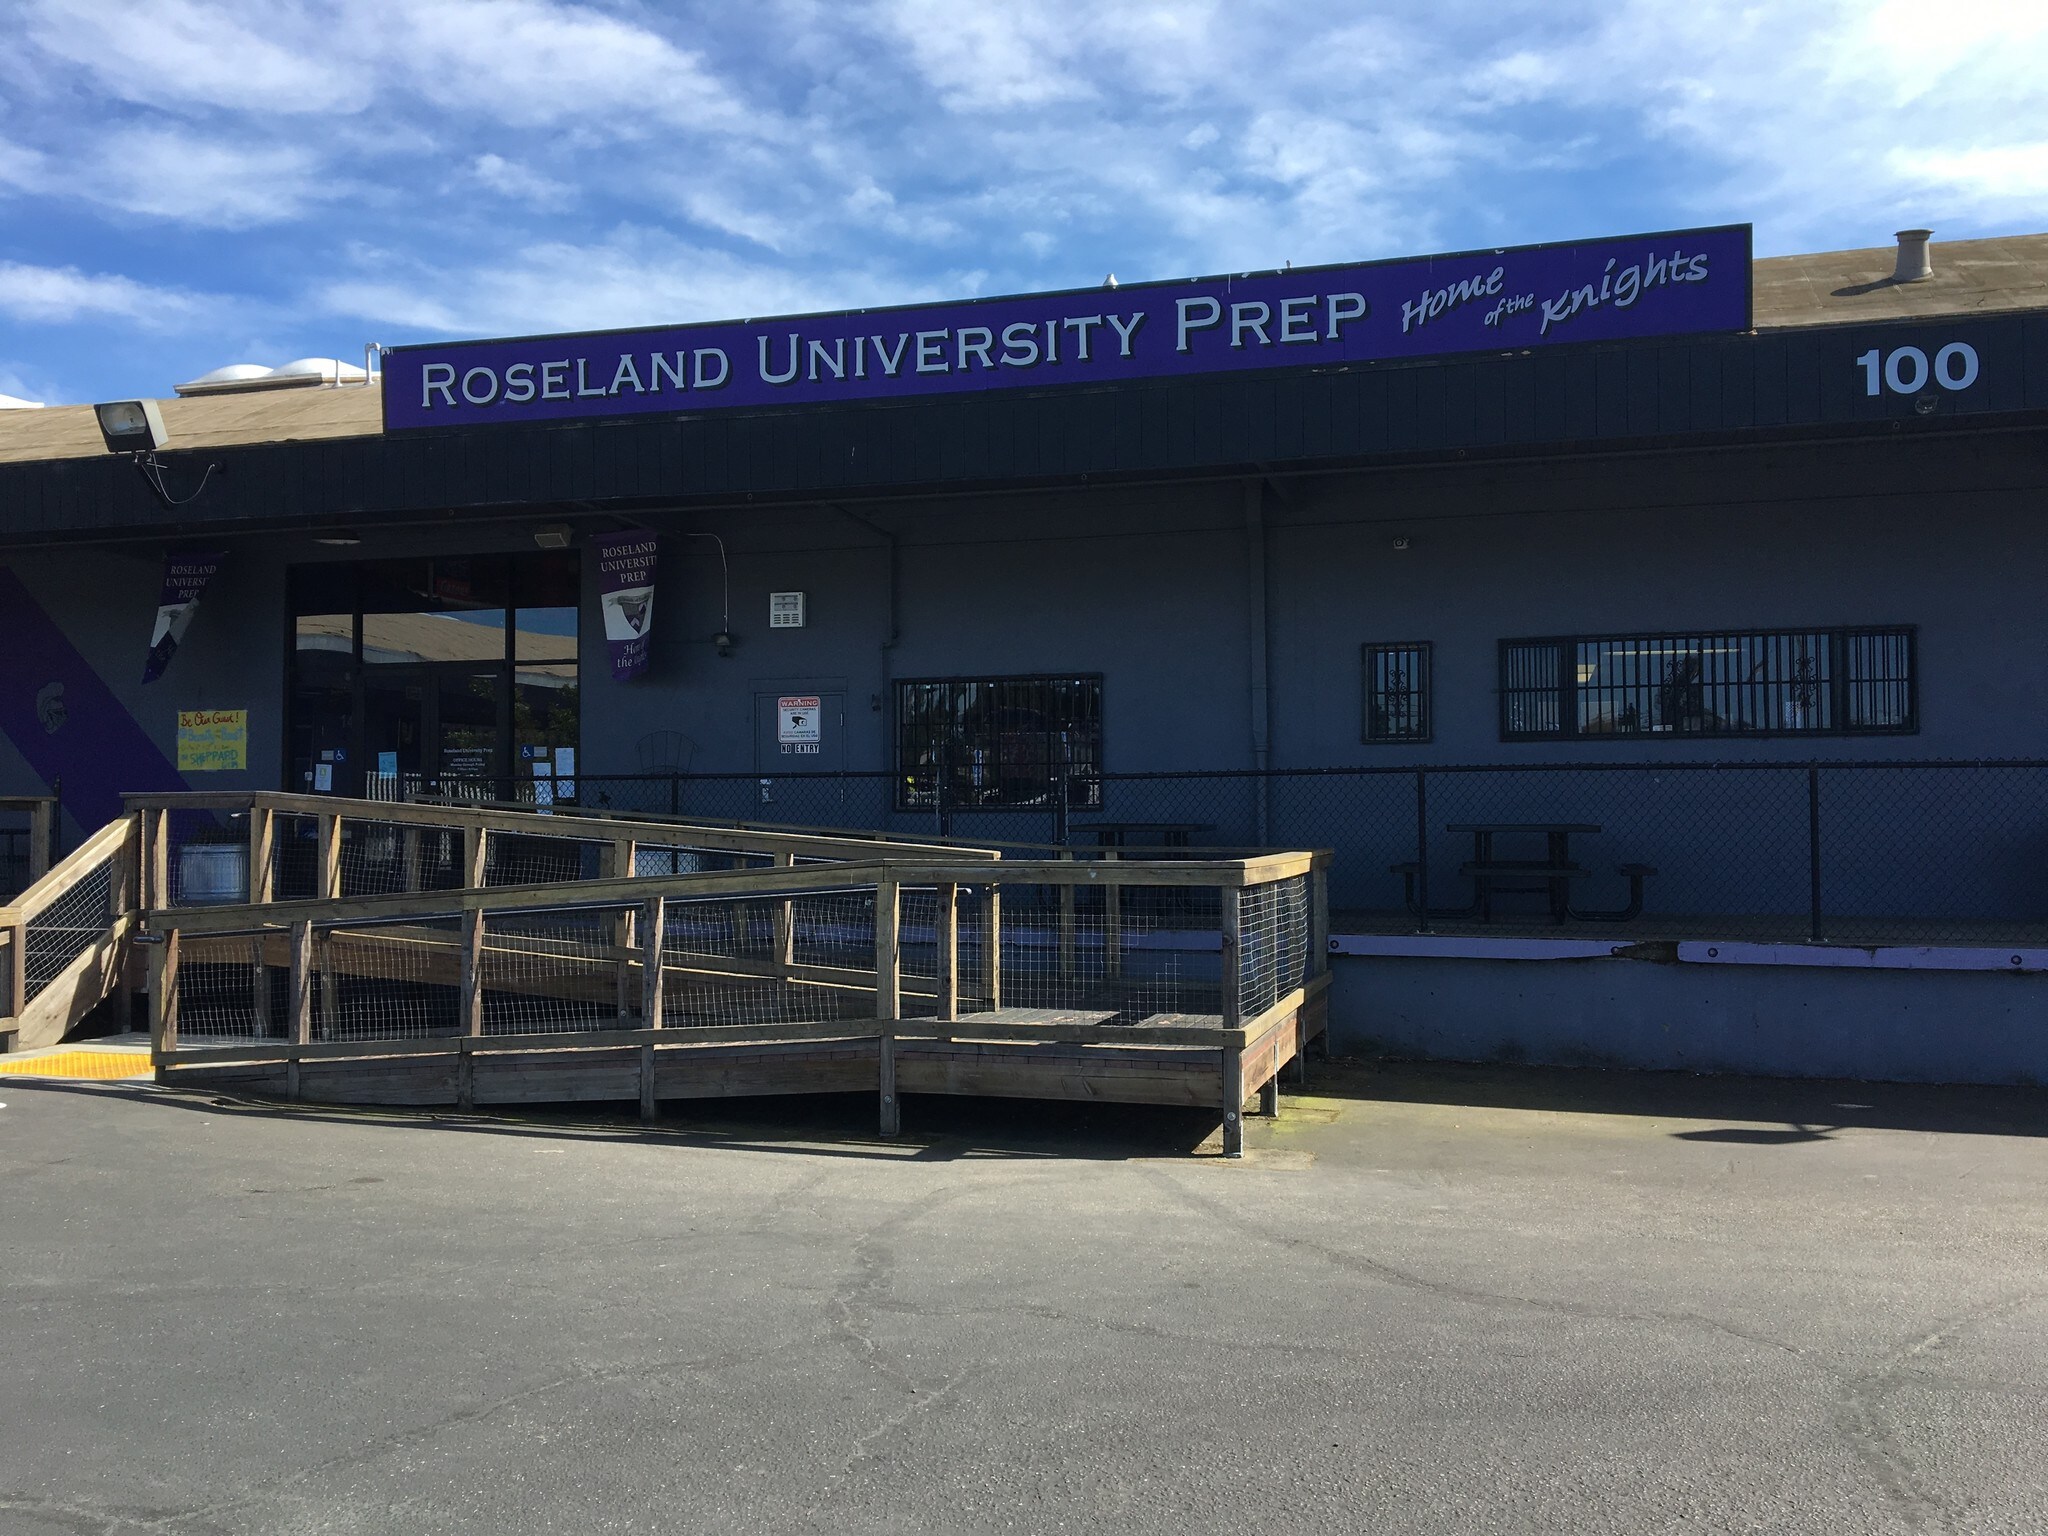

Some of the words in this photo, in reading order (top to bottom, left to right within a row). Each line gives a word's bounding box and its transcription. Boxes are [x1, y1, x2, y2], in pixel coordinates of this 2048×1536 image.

[1401, 265, 1504, 333] Home
[1539, 248, 1709, 335] Knights
[1484, 297, 1507, 326] of
[1506, 292, 1534, 315] the
[421, 347, 730, 408] ROSELAND
[757, 311, 1146, 385] UNIVERSITY
[1175, 291, 1367, 353] PREP
[1856, 340, 1979, 396] 100
[602, 541, 657, 558] ROSELAND
[170, 565, 217, 575] ROSELAND
[600, 555, 657, 572] UNIVERSIT
[620, 570, 647, 583] PREP
[781, 745, 791, 753] NO
[796, 744, 819, 753] ENTRY
